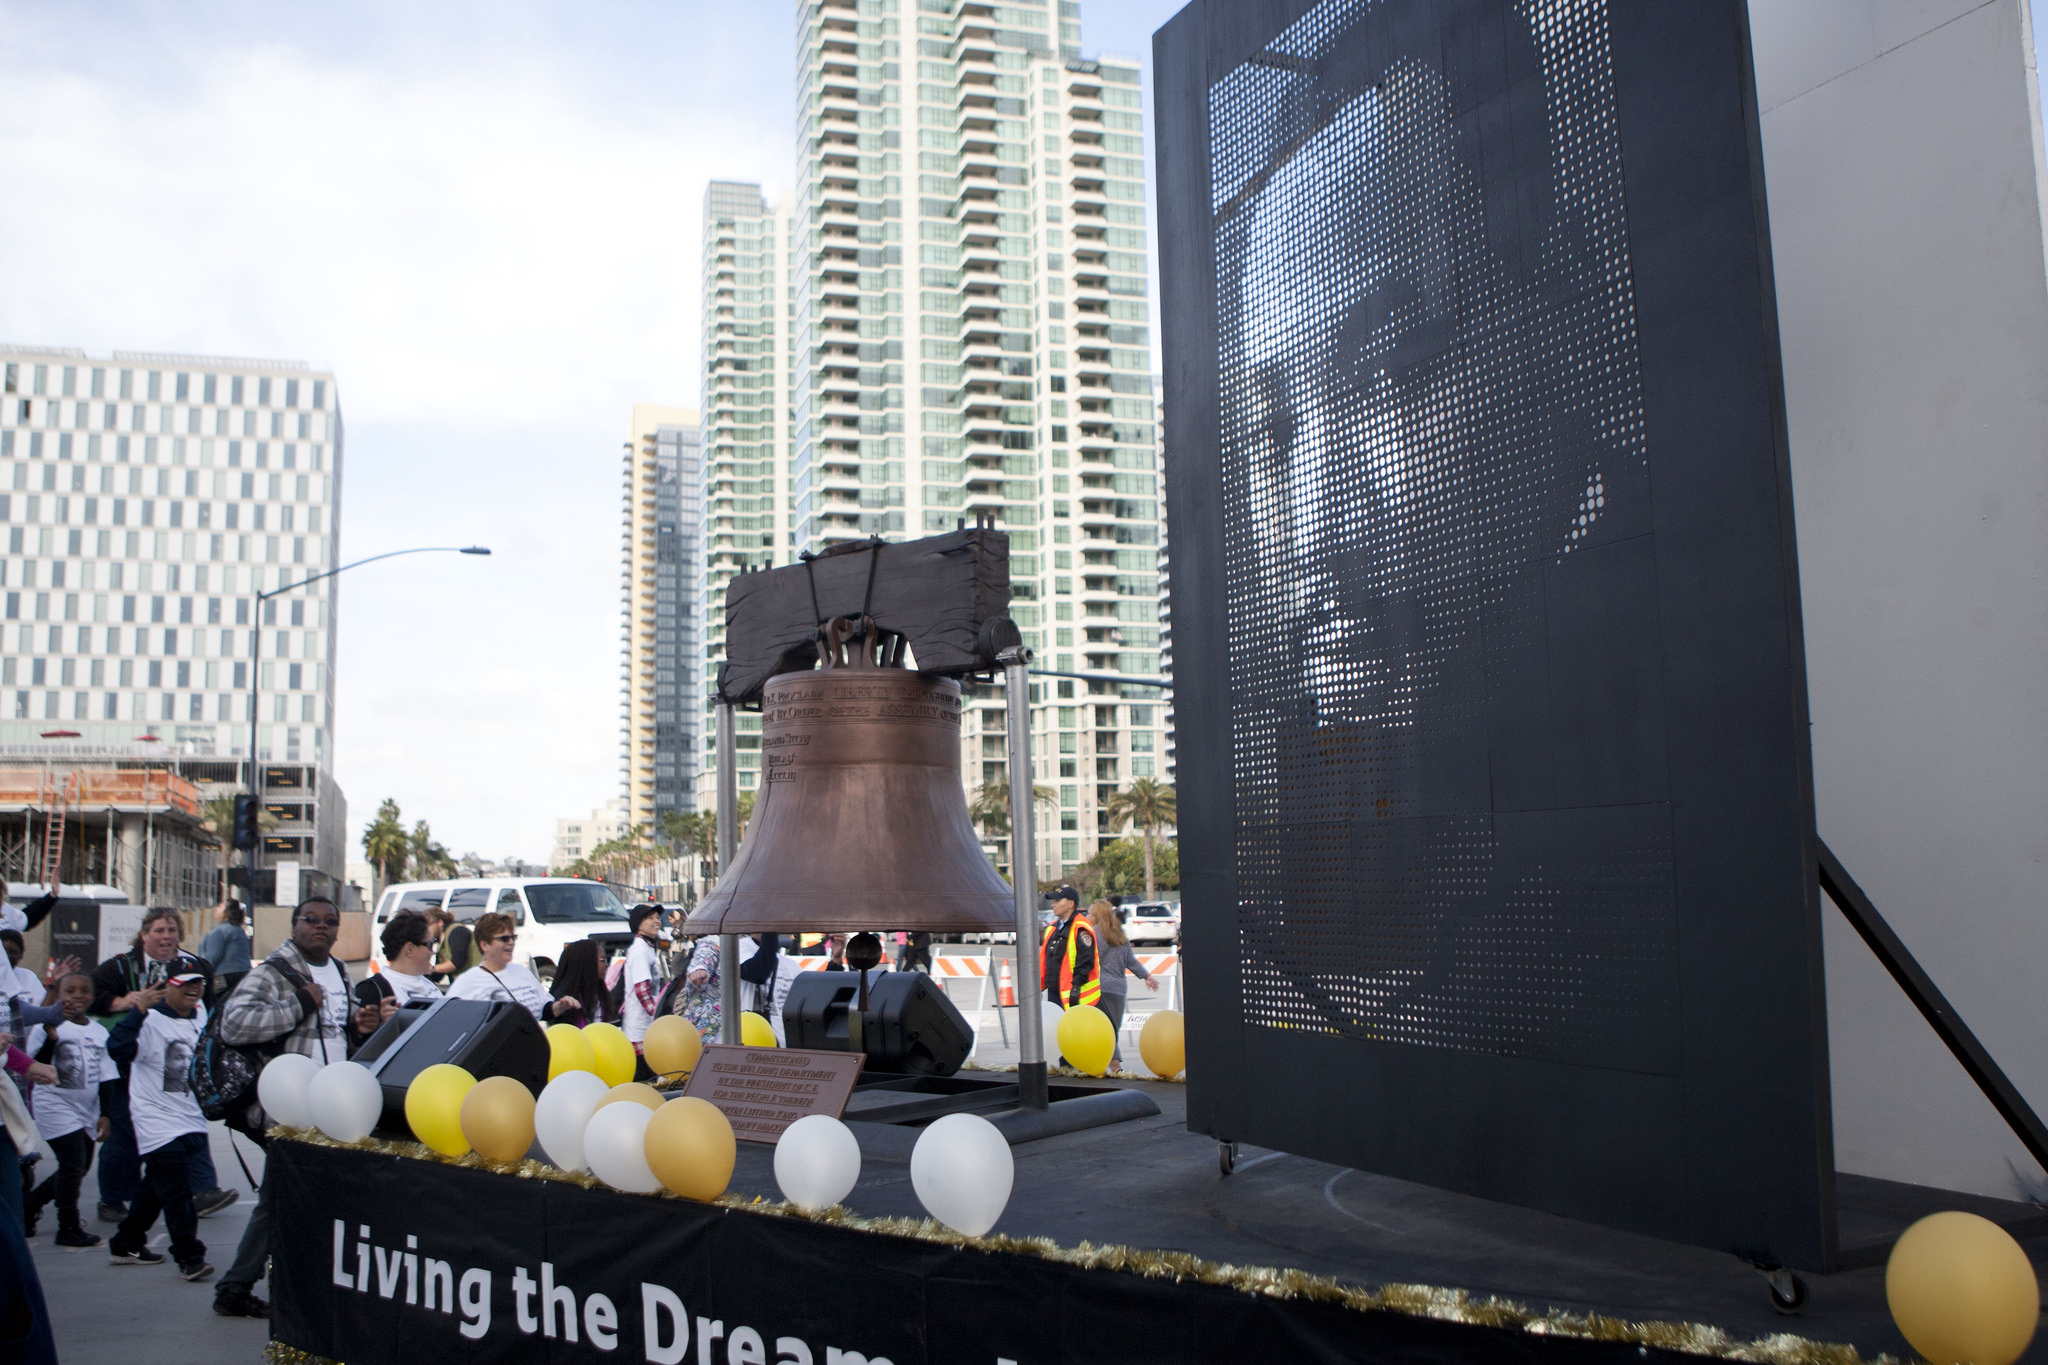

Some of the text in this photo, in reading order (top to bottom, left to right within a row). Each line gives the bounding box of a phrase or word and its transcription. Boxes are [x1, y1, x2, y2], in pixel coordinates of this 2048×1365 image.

[834, 686, 893, 698] LIBERTY
[878, 704, 938, 718] ASSEMBLY
[746, 1053, 811, 1065] COMMISSIONED
[723, 1064, 740, 1072] THE
[740, 1065, 779, 1076] WELDING
[780, 1068, 837, 1080] DEPARTMENT
[718, 1077, 730, 1085] BY
[730, 1078, 745, 1087] THE
[745, 1079, 792, 1091] PRESIDENT
[792, 1083, 804, 1092] OF
[713, 1090, 816, 1107] FOR THE PEOPLE THEREOF
[719, 1105, 743, 1117] ARTIN
[743, 1107, 776, 1119] LUTHER
[776, 1110, 799, 1120] KING
[333, 1219, 492, 1338] Living
[512, 1262, 618, 1351] the
